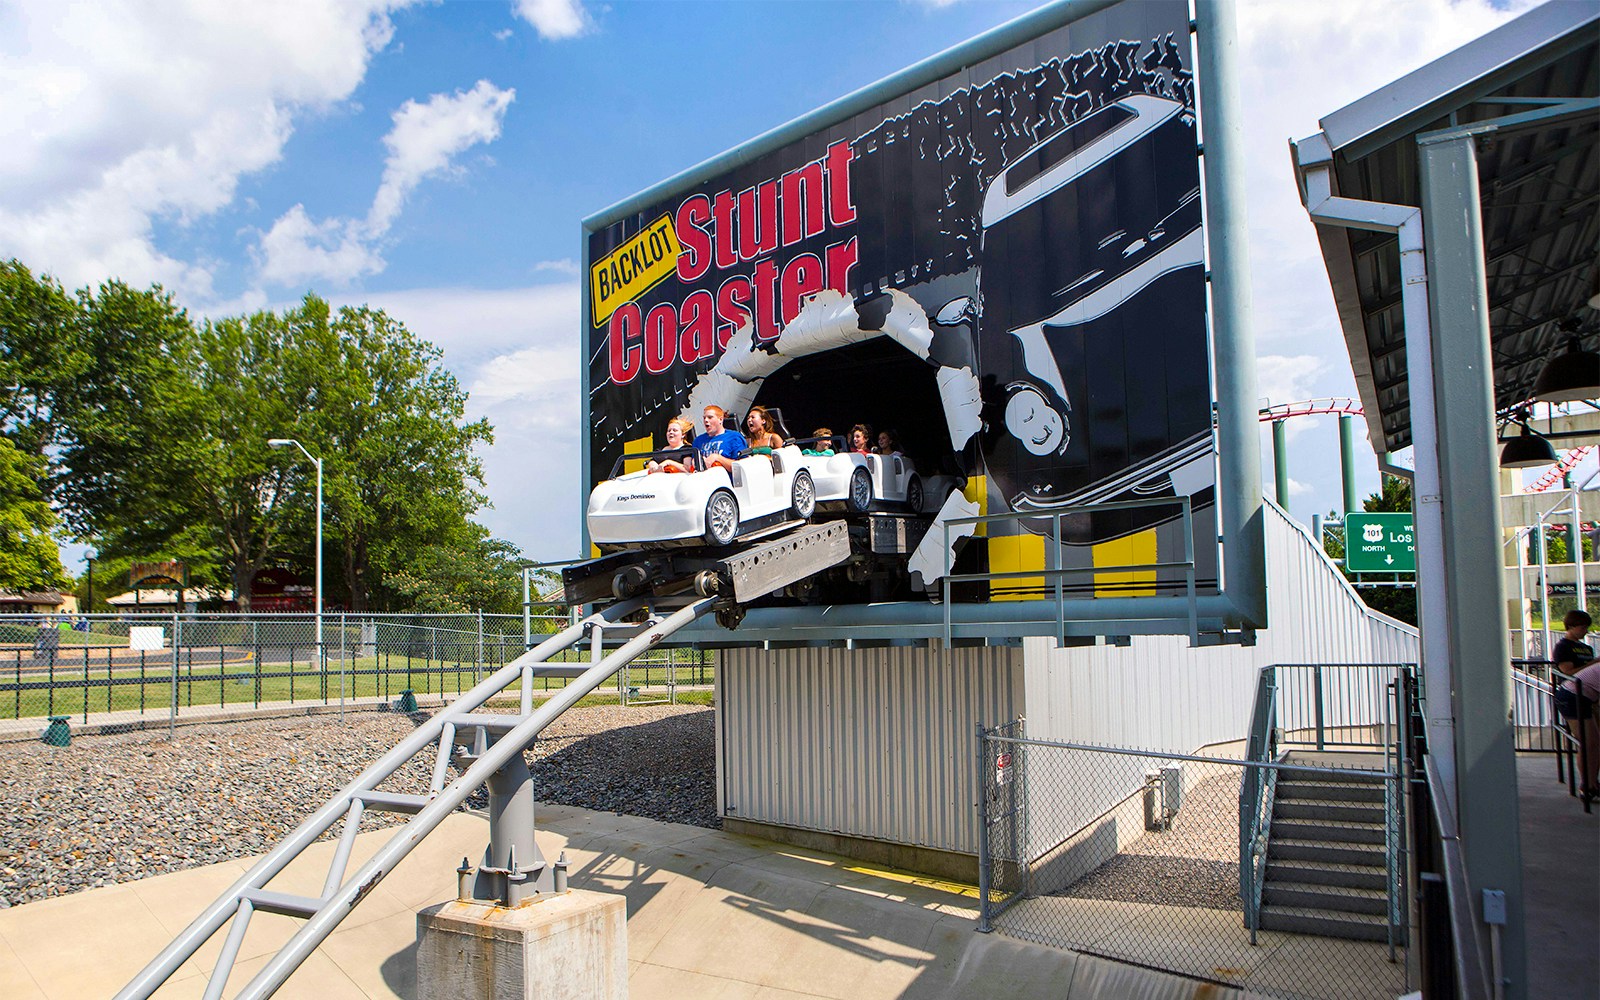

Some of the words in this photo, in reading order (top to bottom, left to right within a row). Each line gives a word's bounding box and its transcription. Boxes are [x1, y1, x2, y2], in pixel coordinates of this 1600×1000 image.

[600, 224, 672, 302] BACKLOT
[675, 138, 857, 283] Stunt
[609, 236, 858, 385] Coaster
